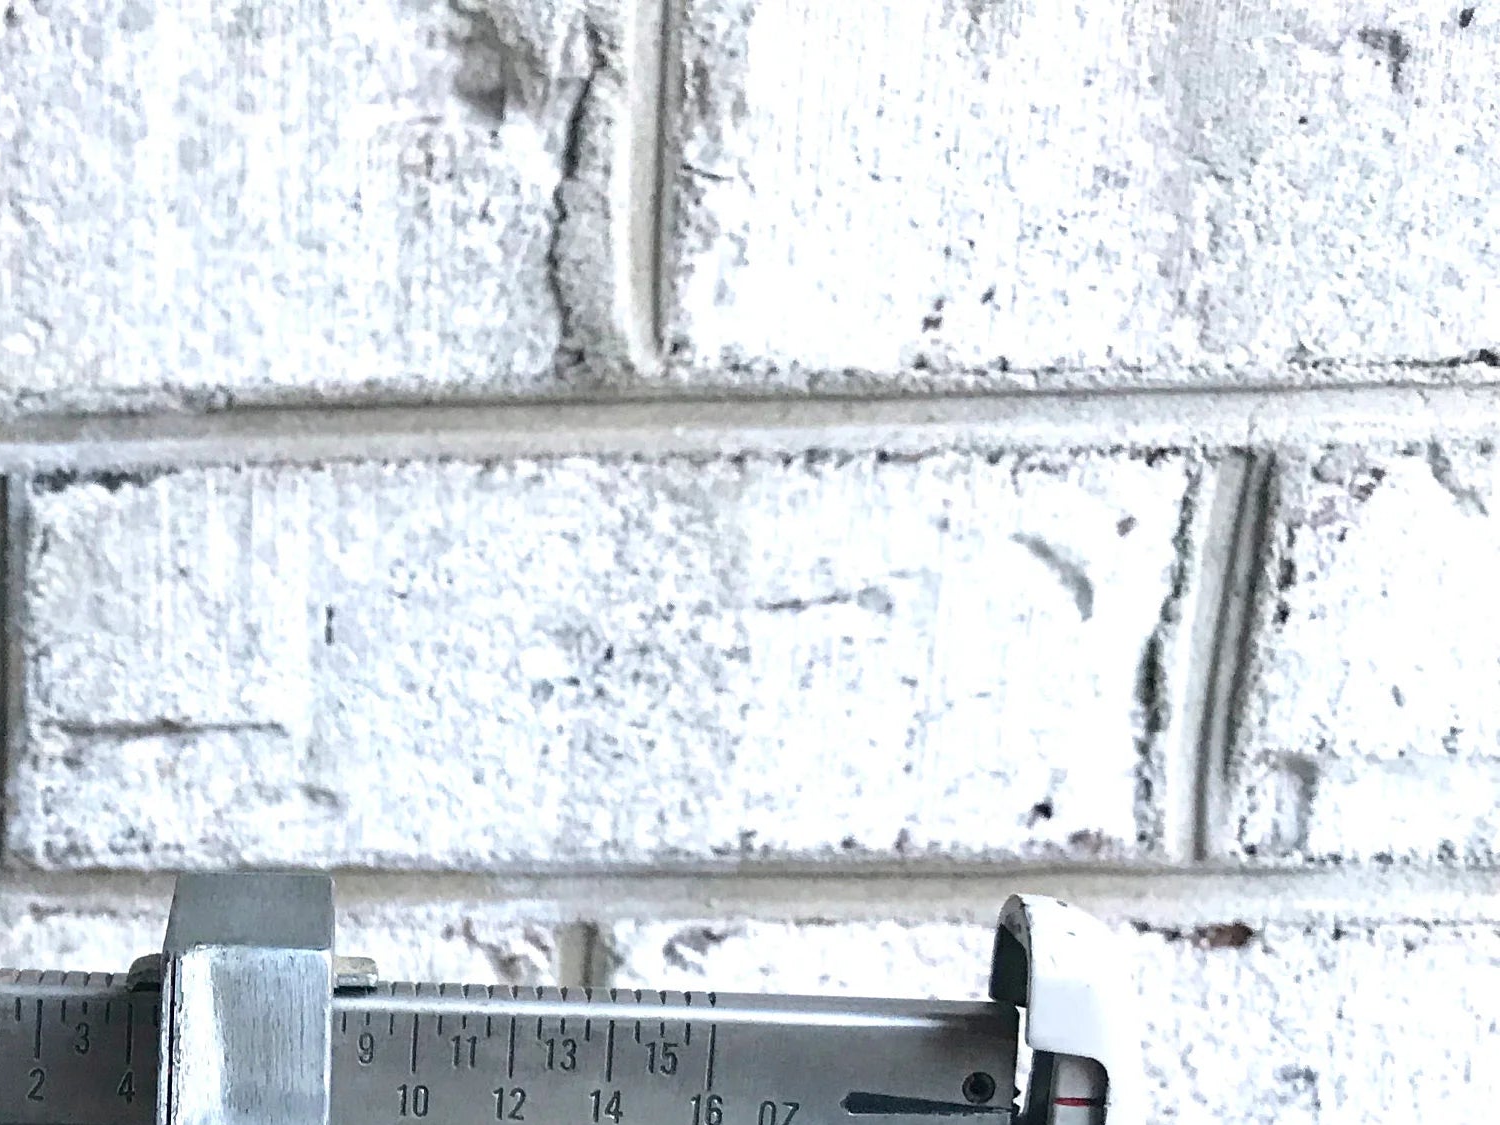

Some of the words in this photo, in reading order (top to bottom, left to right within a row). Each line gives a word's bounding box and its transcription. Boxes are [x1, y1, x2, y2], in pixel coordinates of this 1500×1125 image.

[74, 1022, 91, 1056] 3
[357, 1031, 375, 1066] 9
[451, 1035, 478, 1070] 11
[545, 1038, 577, 1072] 13
[646, 1041, 679, 1076] 15
[27, 1067, 45, 1102] 2
[117, 1070, 136, 1104] 4
[398, 1084, 430, 1118] 10
[493, 1089, 526, 1122] 12
[589, 1091, 624, 1125] 14
